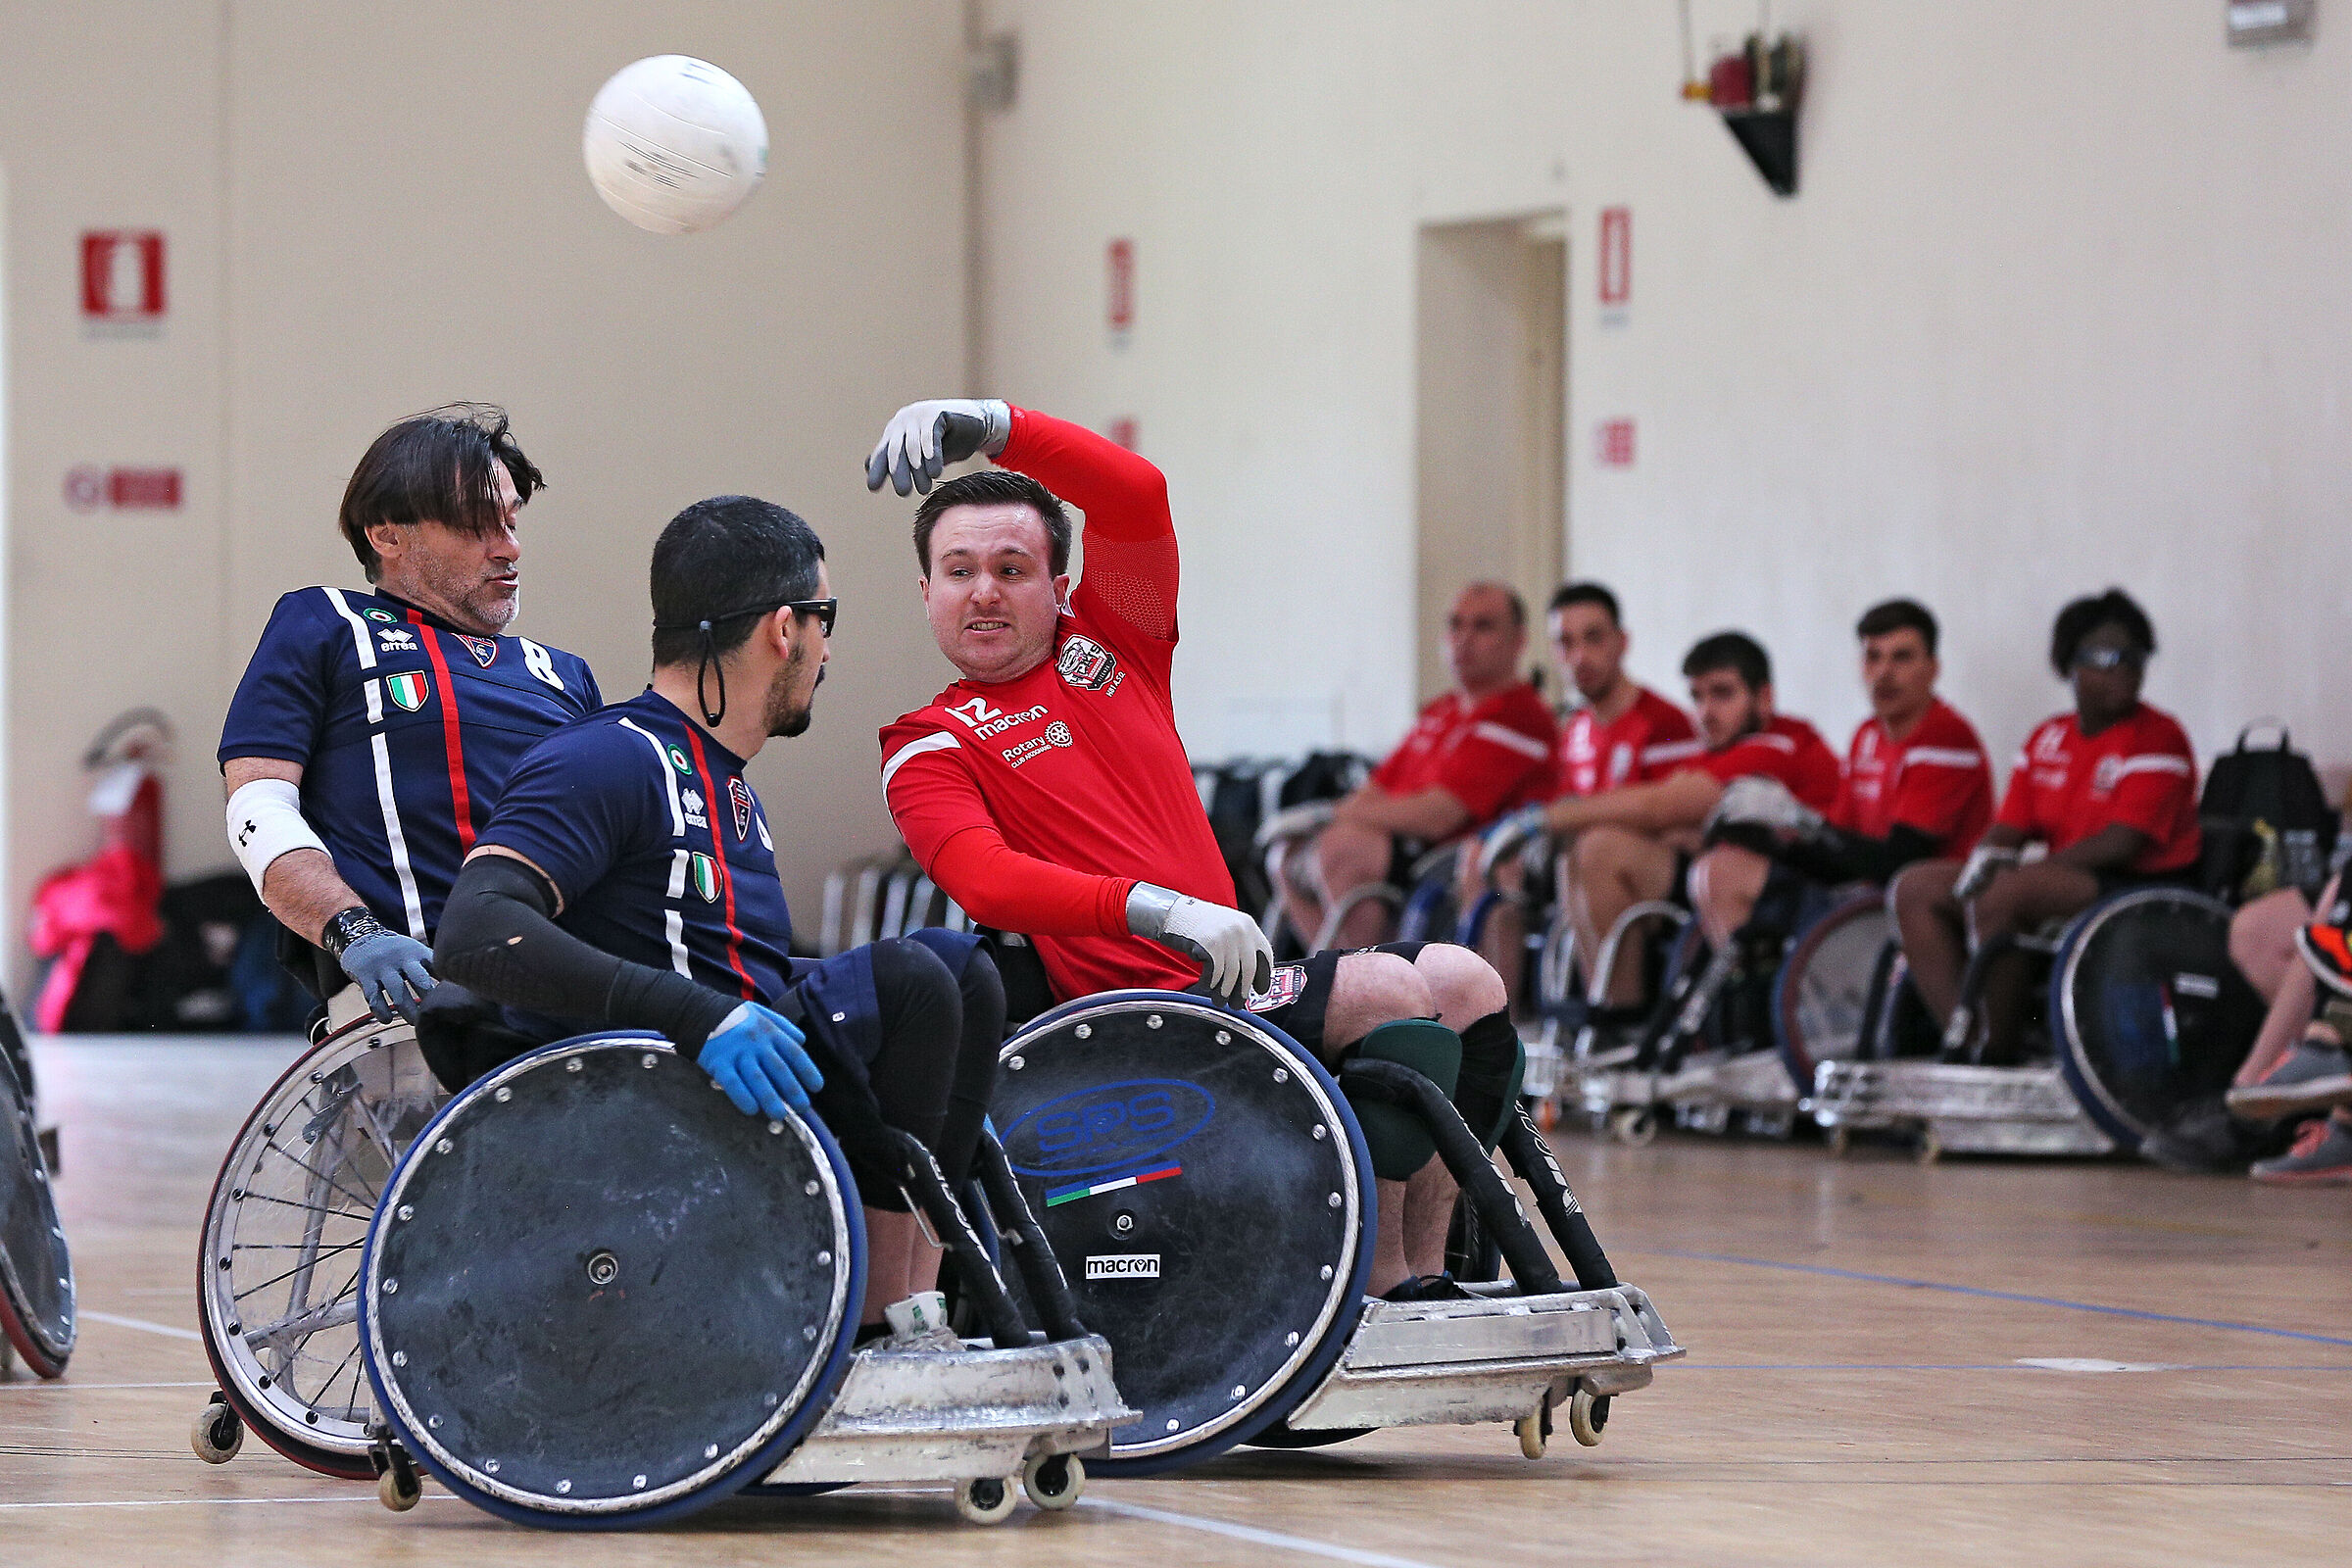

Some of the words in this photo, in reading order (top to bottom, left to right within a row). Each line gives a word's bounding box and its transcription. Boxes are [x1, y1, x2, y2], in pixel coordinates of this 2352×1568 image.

[517, 636, 565, 692] 8
[945, 697, 1004, 728] 12
[973, 705, 1050, 741] macron
[1001, 735, 1048, 762] Rotary
[1035, 1090, 1178, 1152] SPS
[1086, 1257, 1159, 1275] macron
